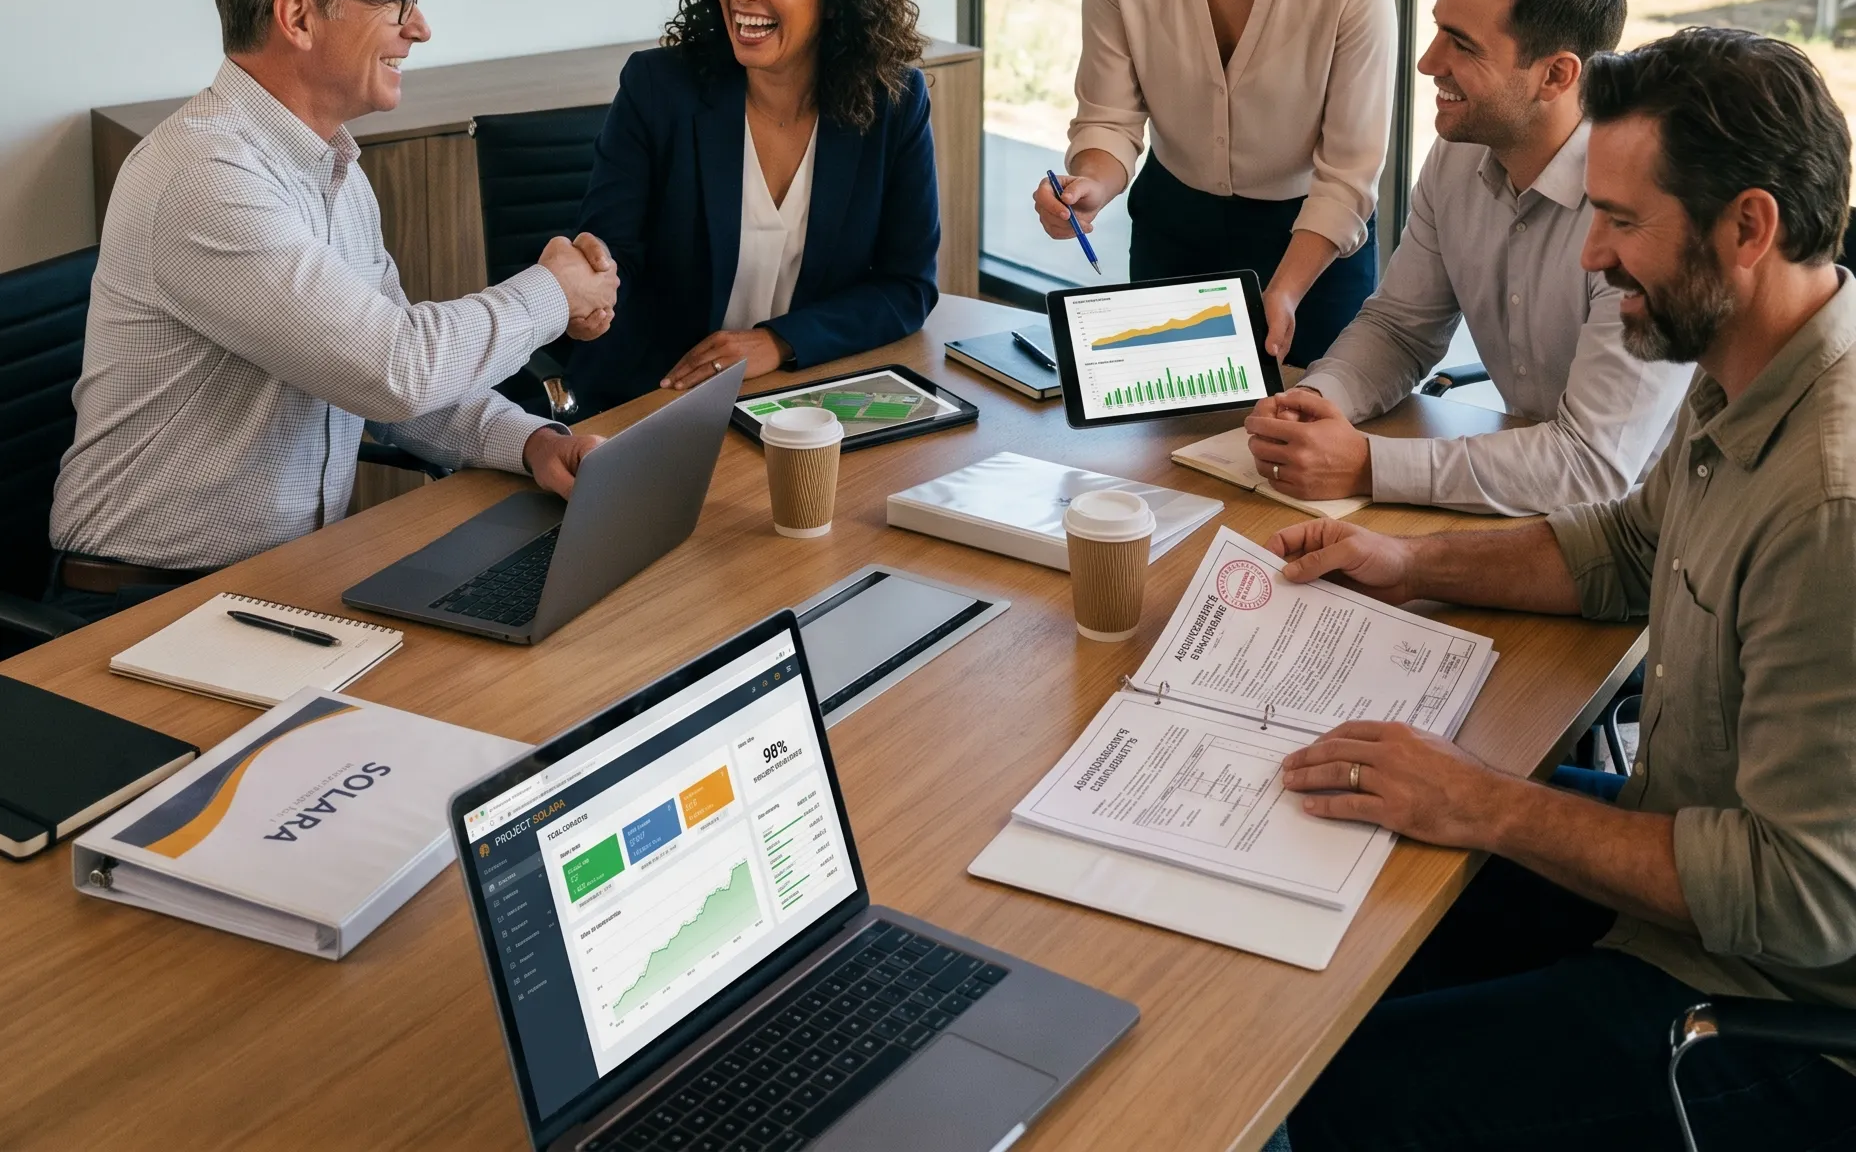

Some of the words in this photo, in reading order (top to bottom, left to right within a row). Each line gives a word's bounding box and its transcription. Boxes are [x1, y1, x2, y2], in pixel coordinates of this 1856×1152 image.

[763, 739, 788, 763] 98%
[263, 762, 391, 841] SOLARA
[494, 817, 531, 846] PROJECT
